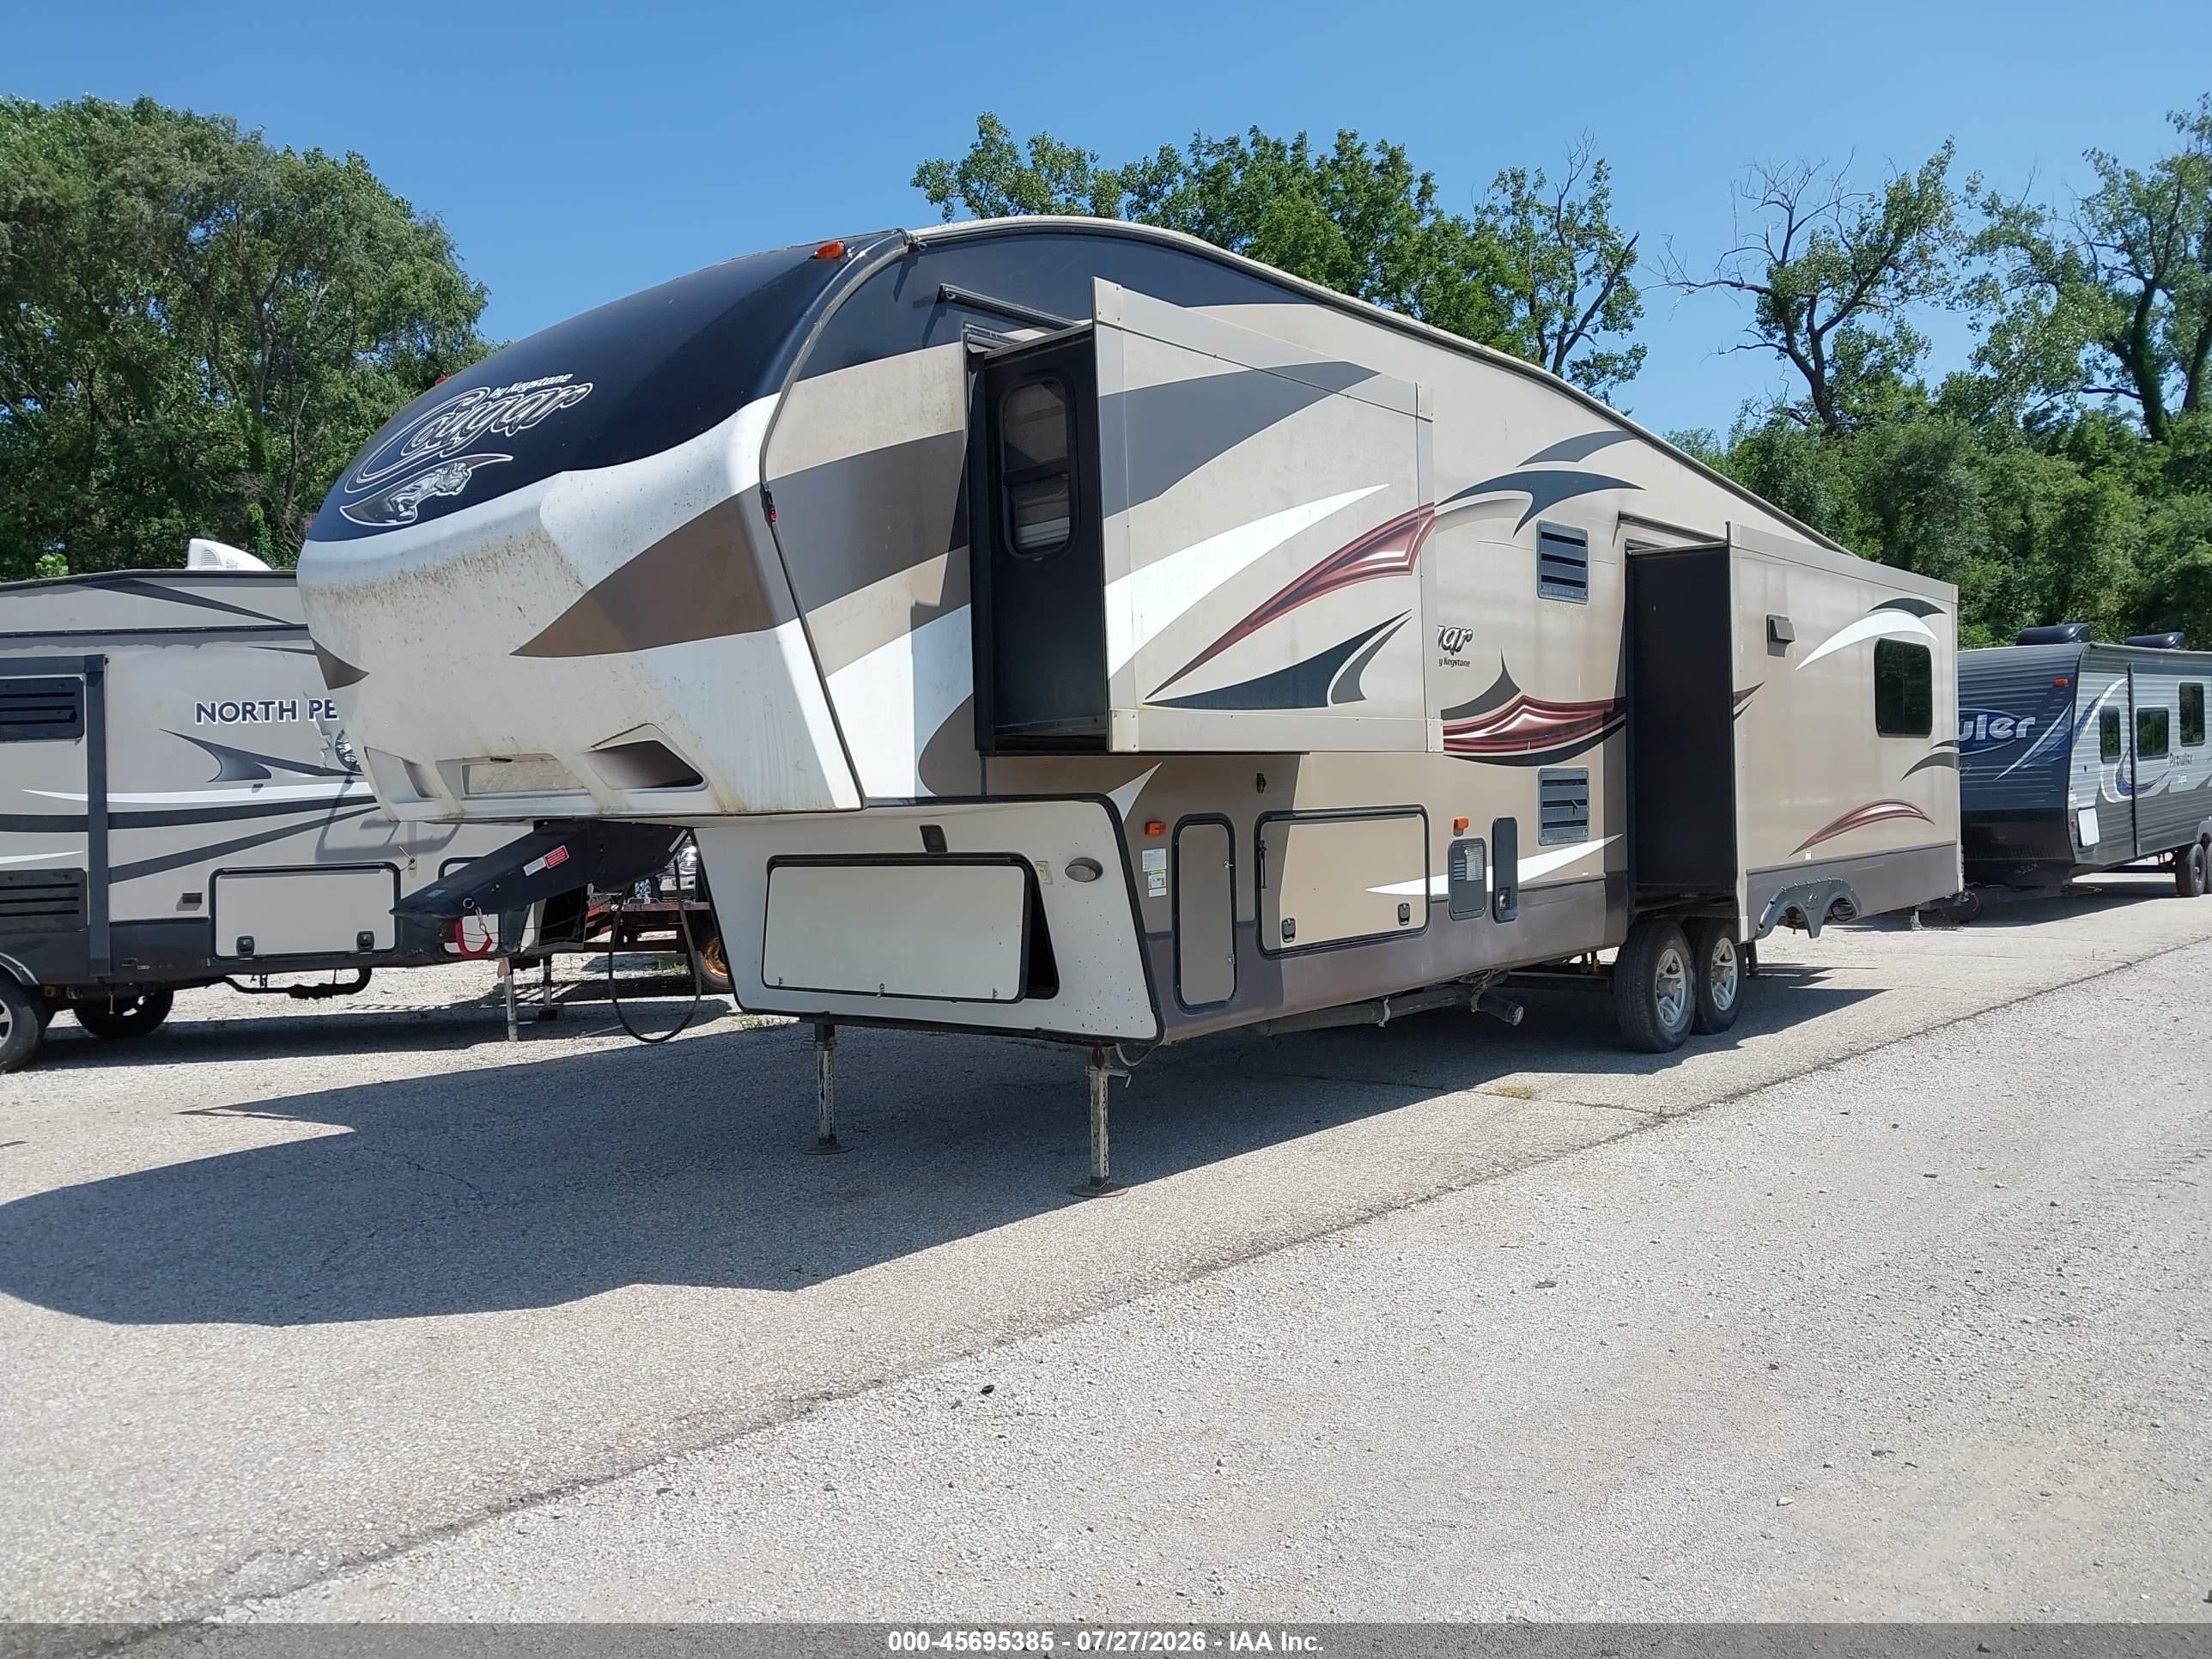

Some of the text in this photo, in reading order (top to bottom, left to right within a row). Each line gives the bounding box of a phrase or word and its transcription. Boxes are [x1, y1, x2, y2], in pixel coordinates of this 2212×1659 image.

[488, 374, 574, 399] by Keystone
[344, 383, 593, 494] Cougar
[1443, 656, 1471, 668] Keystone
[195, 700, 299, 725] NORTH
